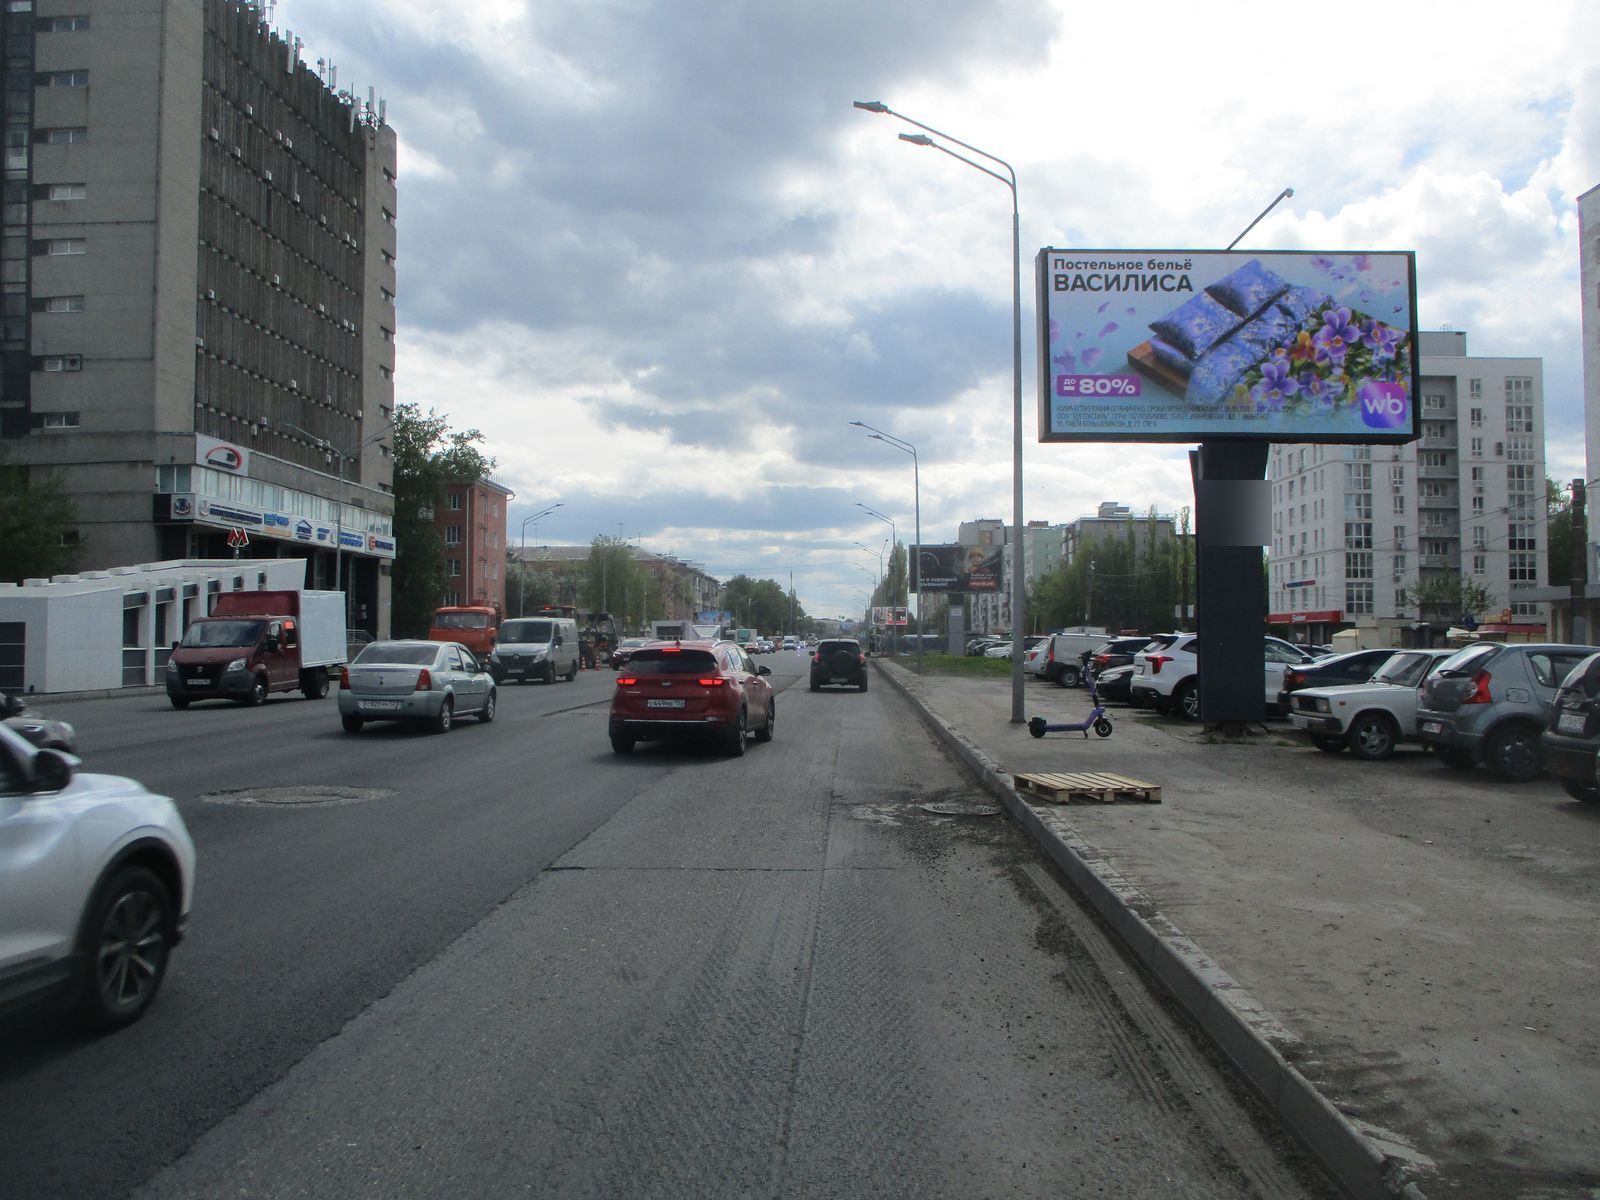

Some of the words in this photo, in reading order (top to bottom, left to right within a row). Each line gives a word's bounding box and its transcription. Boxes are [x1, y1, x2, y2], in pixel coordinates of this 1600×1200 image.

[1054, 258, 1143, 271] Постельное
[1147, 257, 1192, 271] бельё
[1054, 274, 1193, 292] ВАСИЛИСА
[1363, 392, 1404, 415] wb
